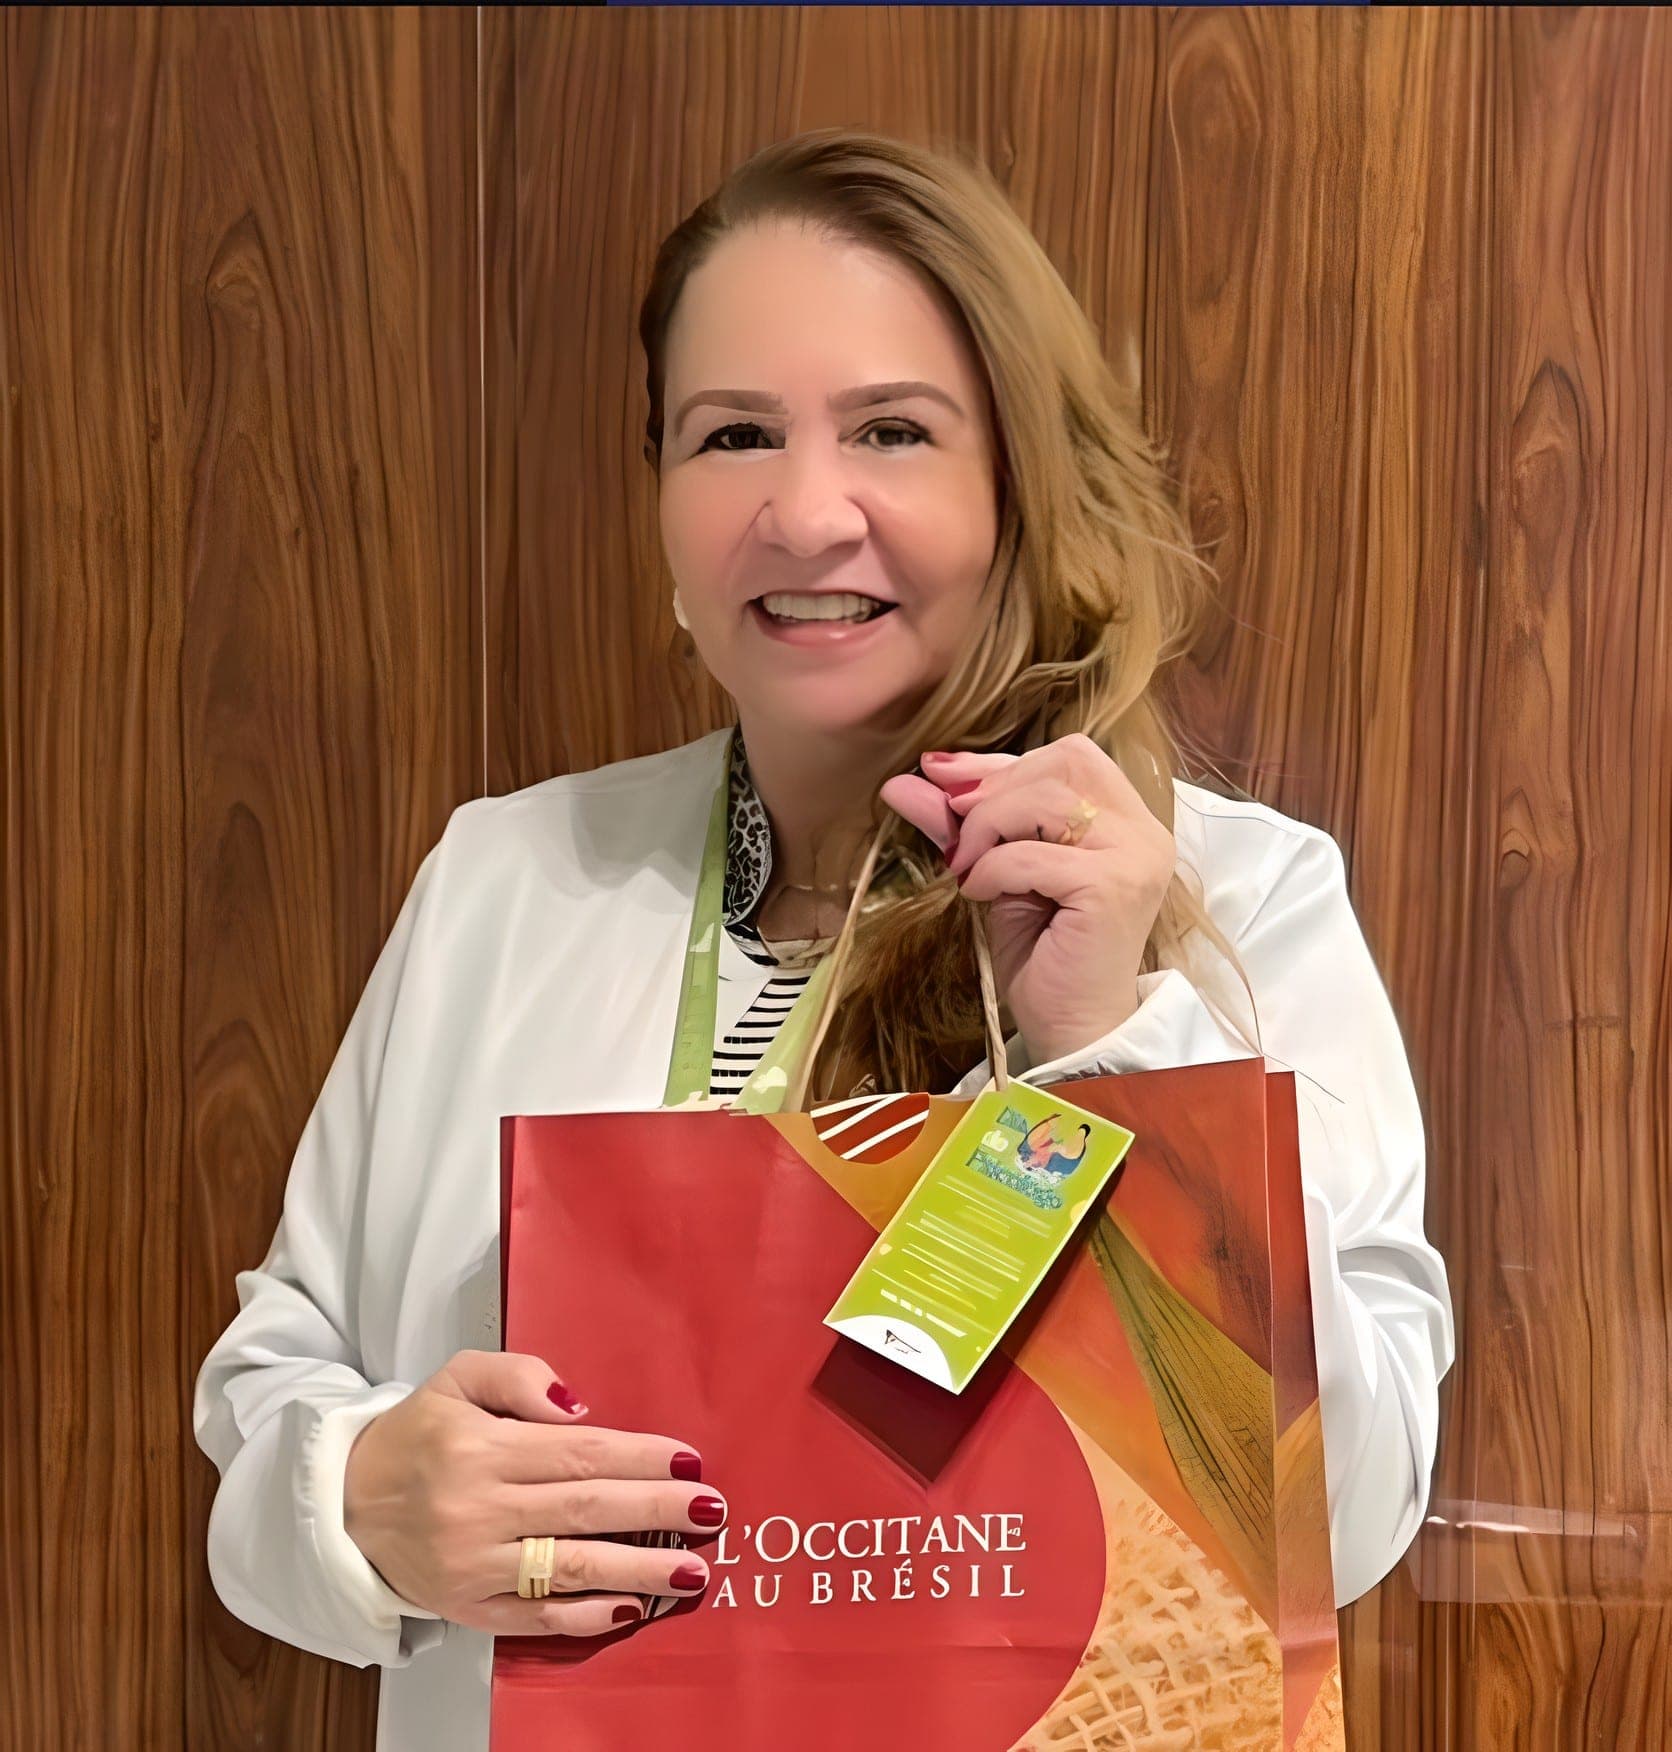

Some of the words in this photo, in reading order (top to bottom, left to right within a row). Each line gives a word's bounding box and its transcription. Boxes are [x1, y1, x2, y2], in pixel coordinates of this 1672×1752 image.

[713, 1513, 1028, 1566] L'OCCITANE
[711, 1574, 784, 1609] AU
[808, 1558, 1026, 1605] BRÉSIL
